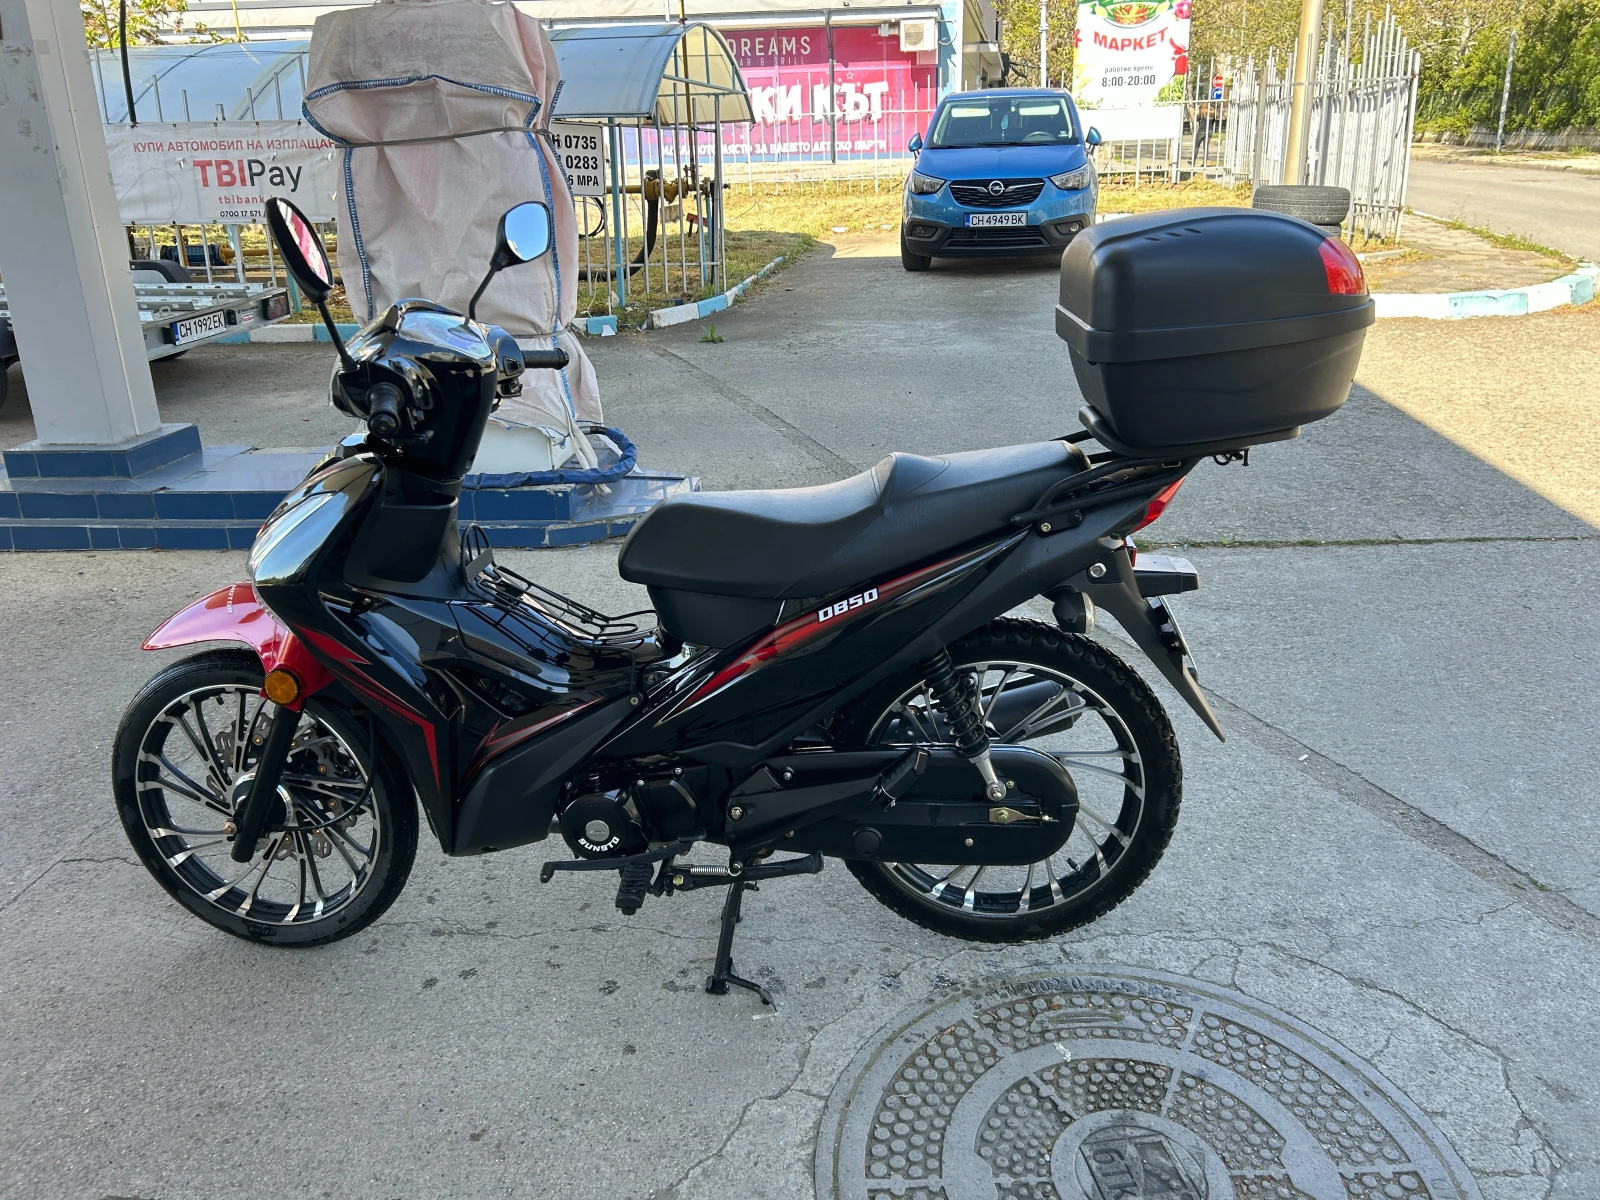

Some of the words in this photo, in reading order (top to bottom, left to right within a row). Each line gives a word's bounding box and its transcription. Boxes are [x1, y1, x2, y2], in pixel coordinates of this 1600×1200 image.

[726, 35, 811, 57] DREAMS
[1093, 26, 1169, 52] МАРКЕТ
[1101, 74, 1156, 87] 8:00-20:00
[746, 84, 803, 124] КИ
[813, 81, 890, 122] КЪТ
[133, 142, 164, 153] КУПИ
[167, 140, 243, 152] АВТОМОБИЛ
[246, 140, 264, 150] НА
[564, 135, 597, 150] 0735
[754, 143, 768, 153] ЗА
[769, 141, 811, 153] ВАШЕТО
[854, 139, 887, 151] ПАРТИ
[565, 155, 598, 170] 0283
[192, 158, 303, 193] TBIPay
[577, 175, 599, 187] MPA
[219, 210, 239, 218] 0700
[249, 210, 262, 218] 571
[971, 215, 984, 226] CH
[985, 214, 1010, 226] 4949
[1011, 214, 1024, 225] BK
[179, 321, 193, 338] CH
[193, 316, 213, 334] 1992
[213, 313, 224, 329] EK
[818, 588, 879, 622] DB50
